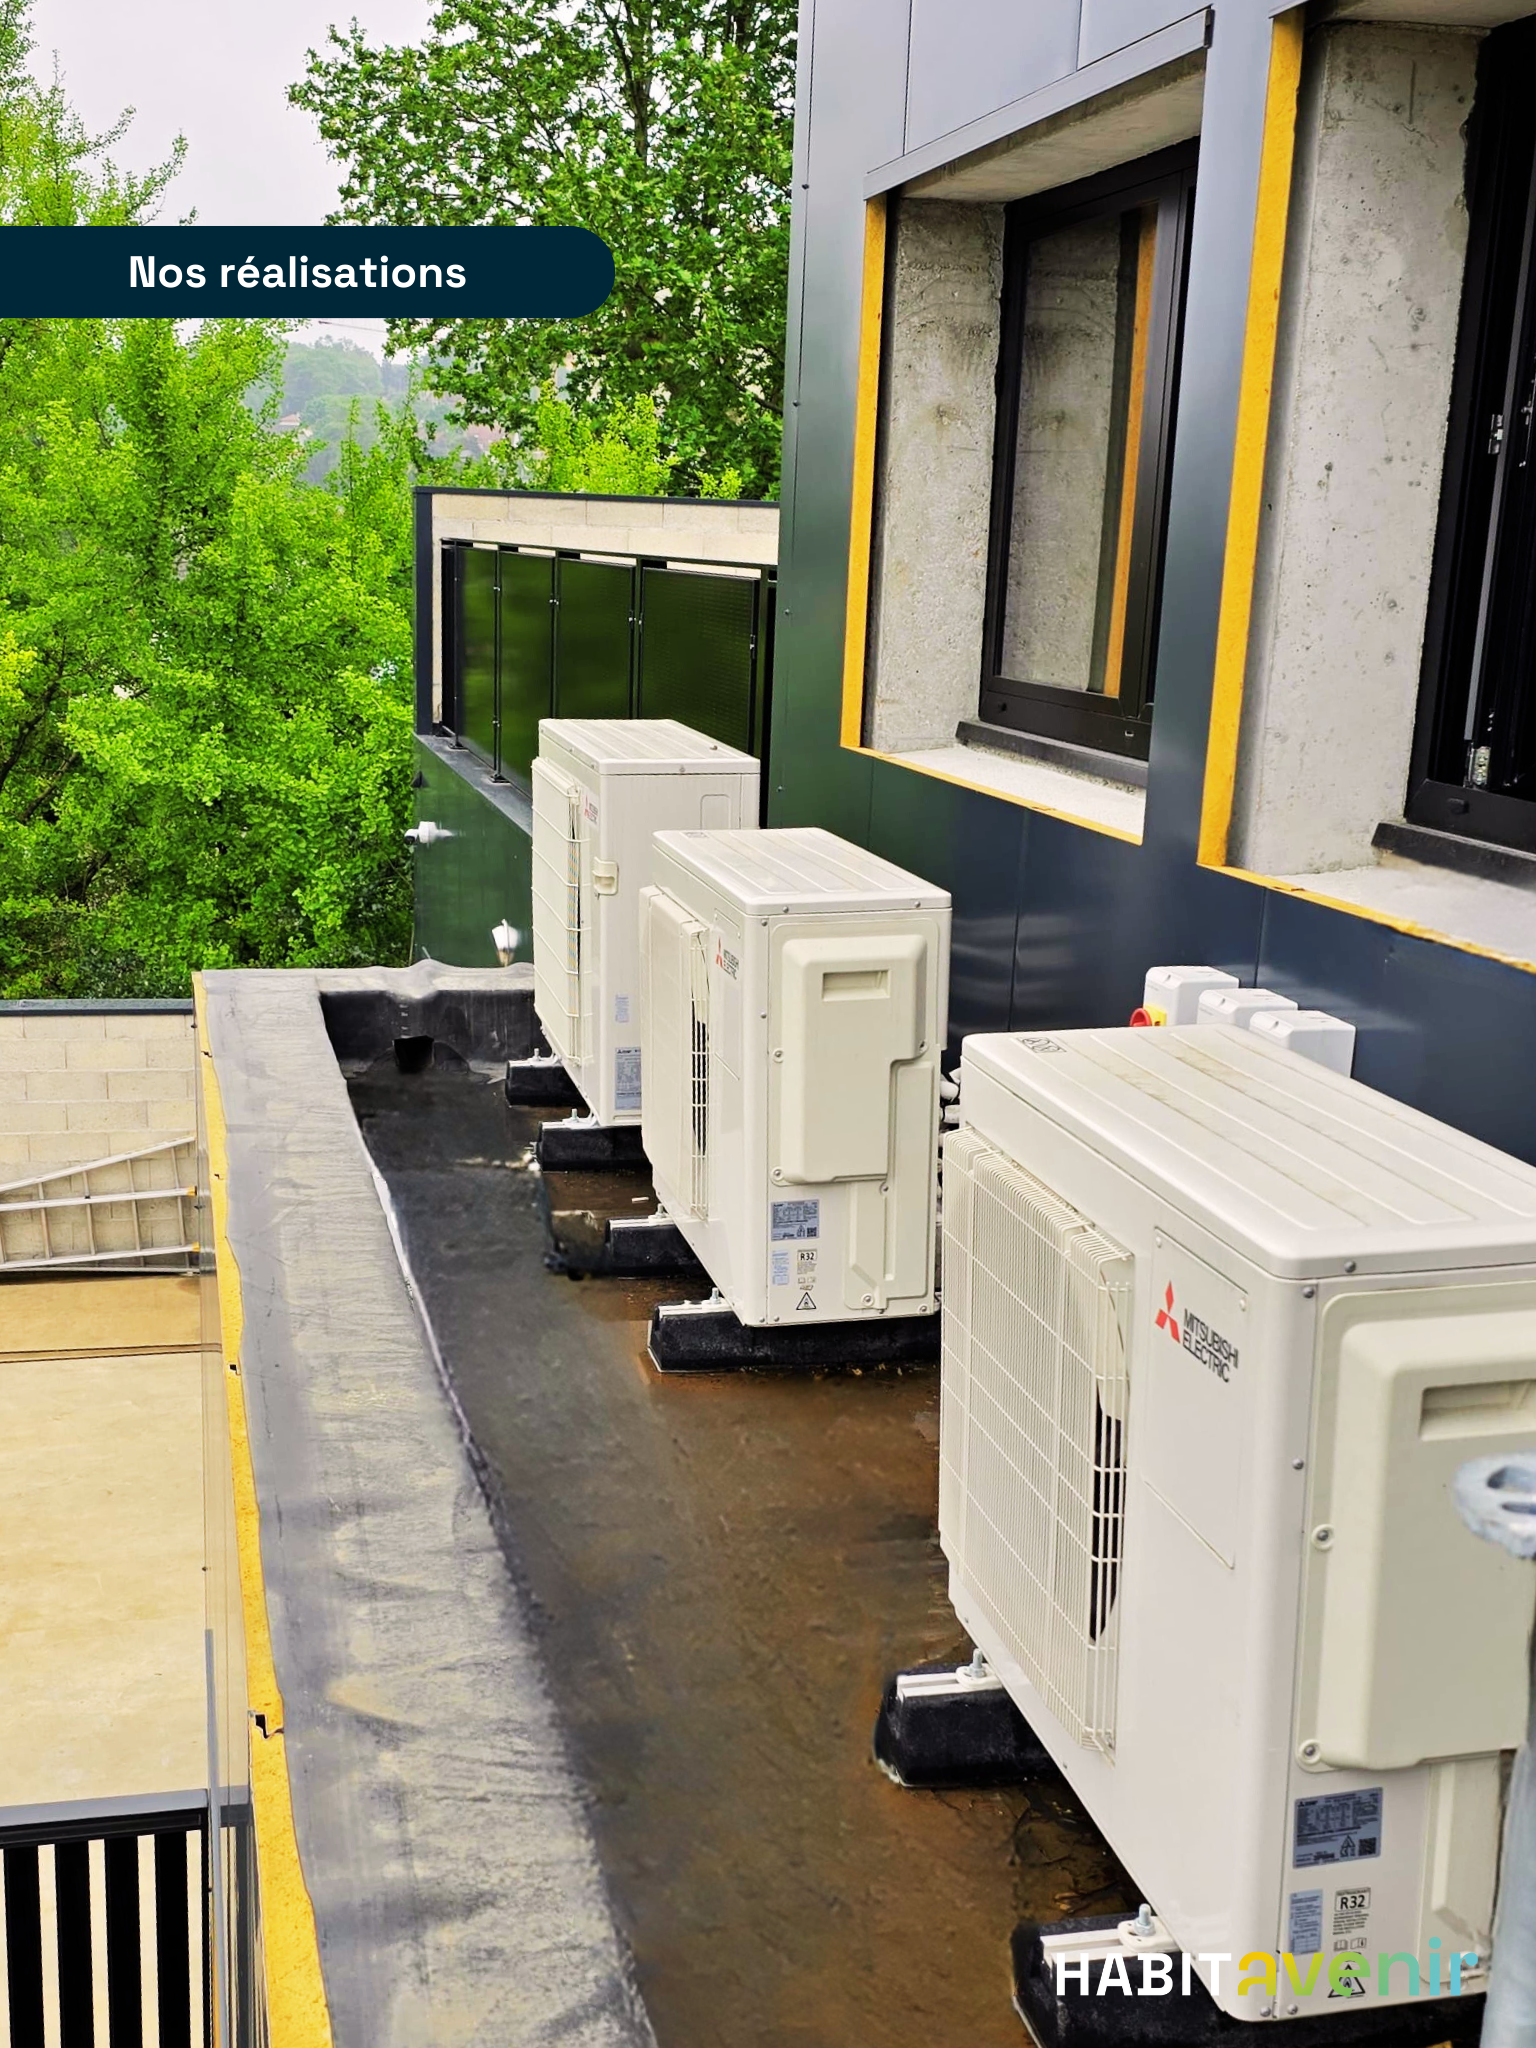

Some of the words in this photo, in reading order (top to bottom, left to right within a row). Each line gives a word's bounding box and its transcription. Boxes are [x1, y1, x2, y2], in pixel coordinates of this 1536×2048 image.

[1182, 1328, 1230, 1383] ELECTRIC
[1184, 1308, 1239, 1370] MITSUBISHI
[1340, 1894, 1365, 1910] R32
